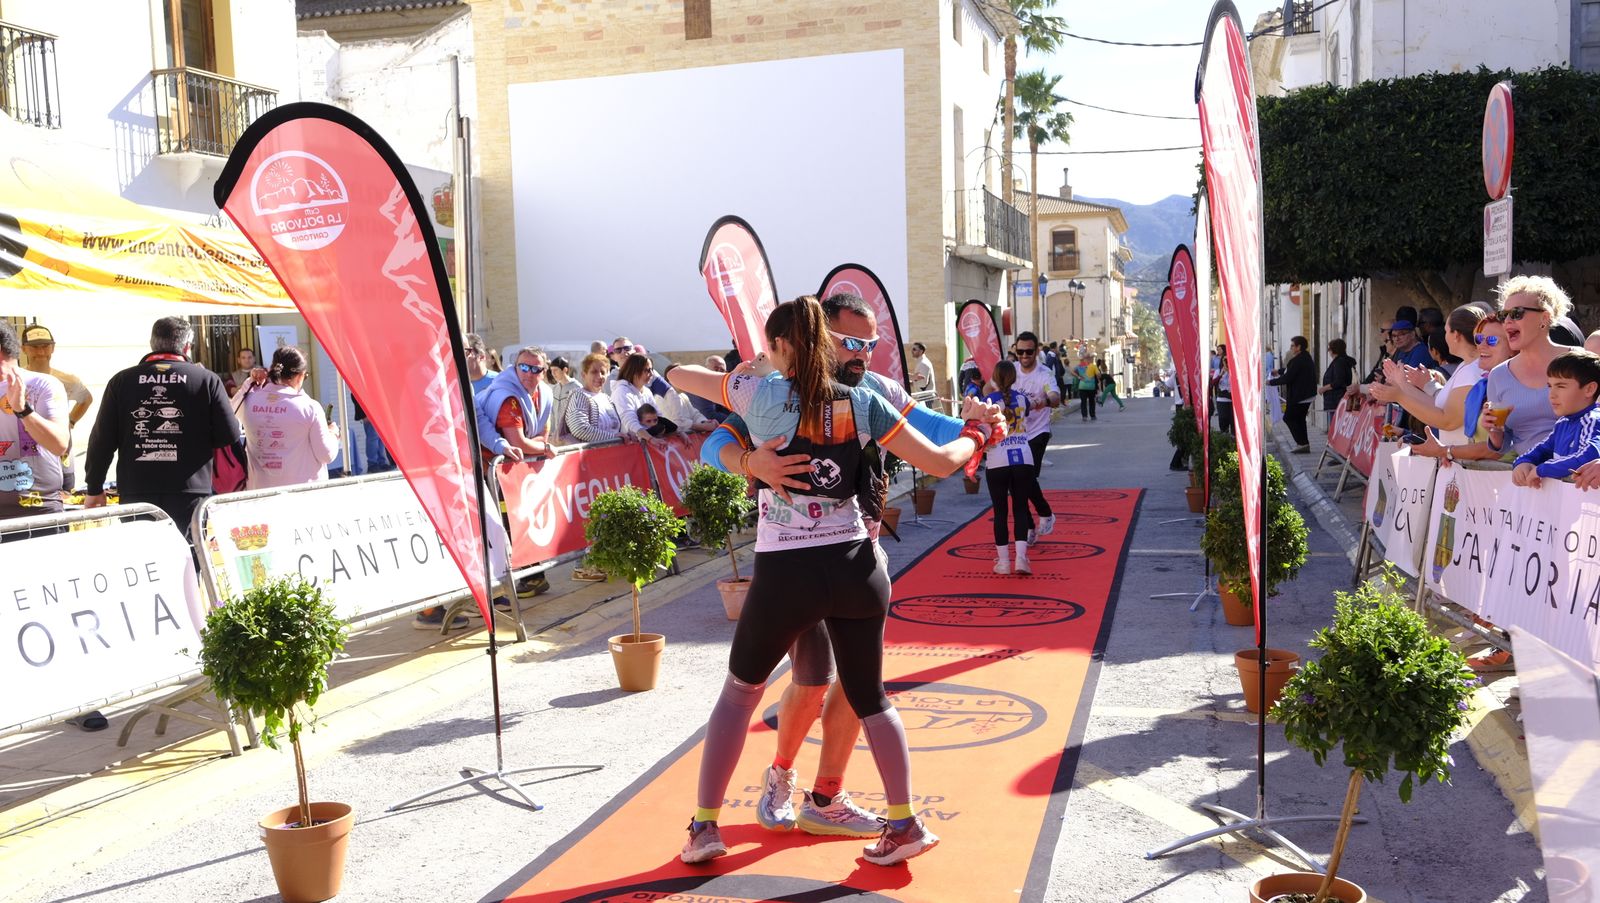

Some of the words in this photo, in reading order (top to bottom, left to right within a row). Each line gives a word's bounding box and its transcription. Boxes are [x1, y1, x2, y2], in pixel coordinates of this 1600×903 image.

[138, 372, 188, 384] BAILÉN
[824, 404, 832, 419] MAX
[124, 562, 160, 587] DE
[976, 699, 1014, 707] LA
